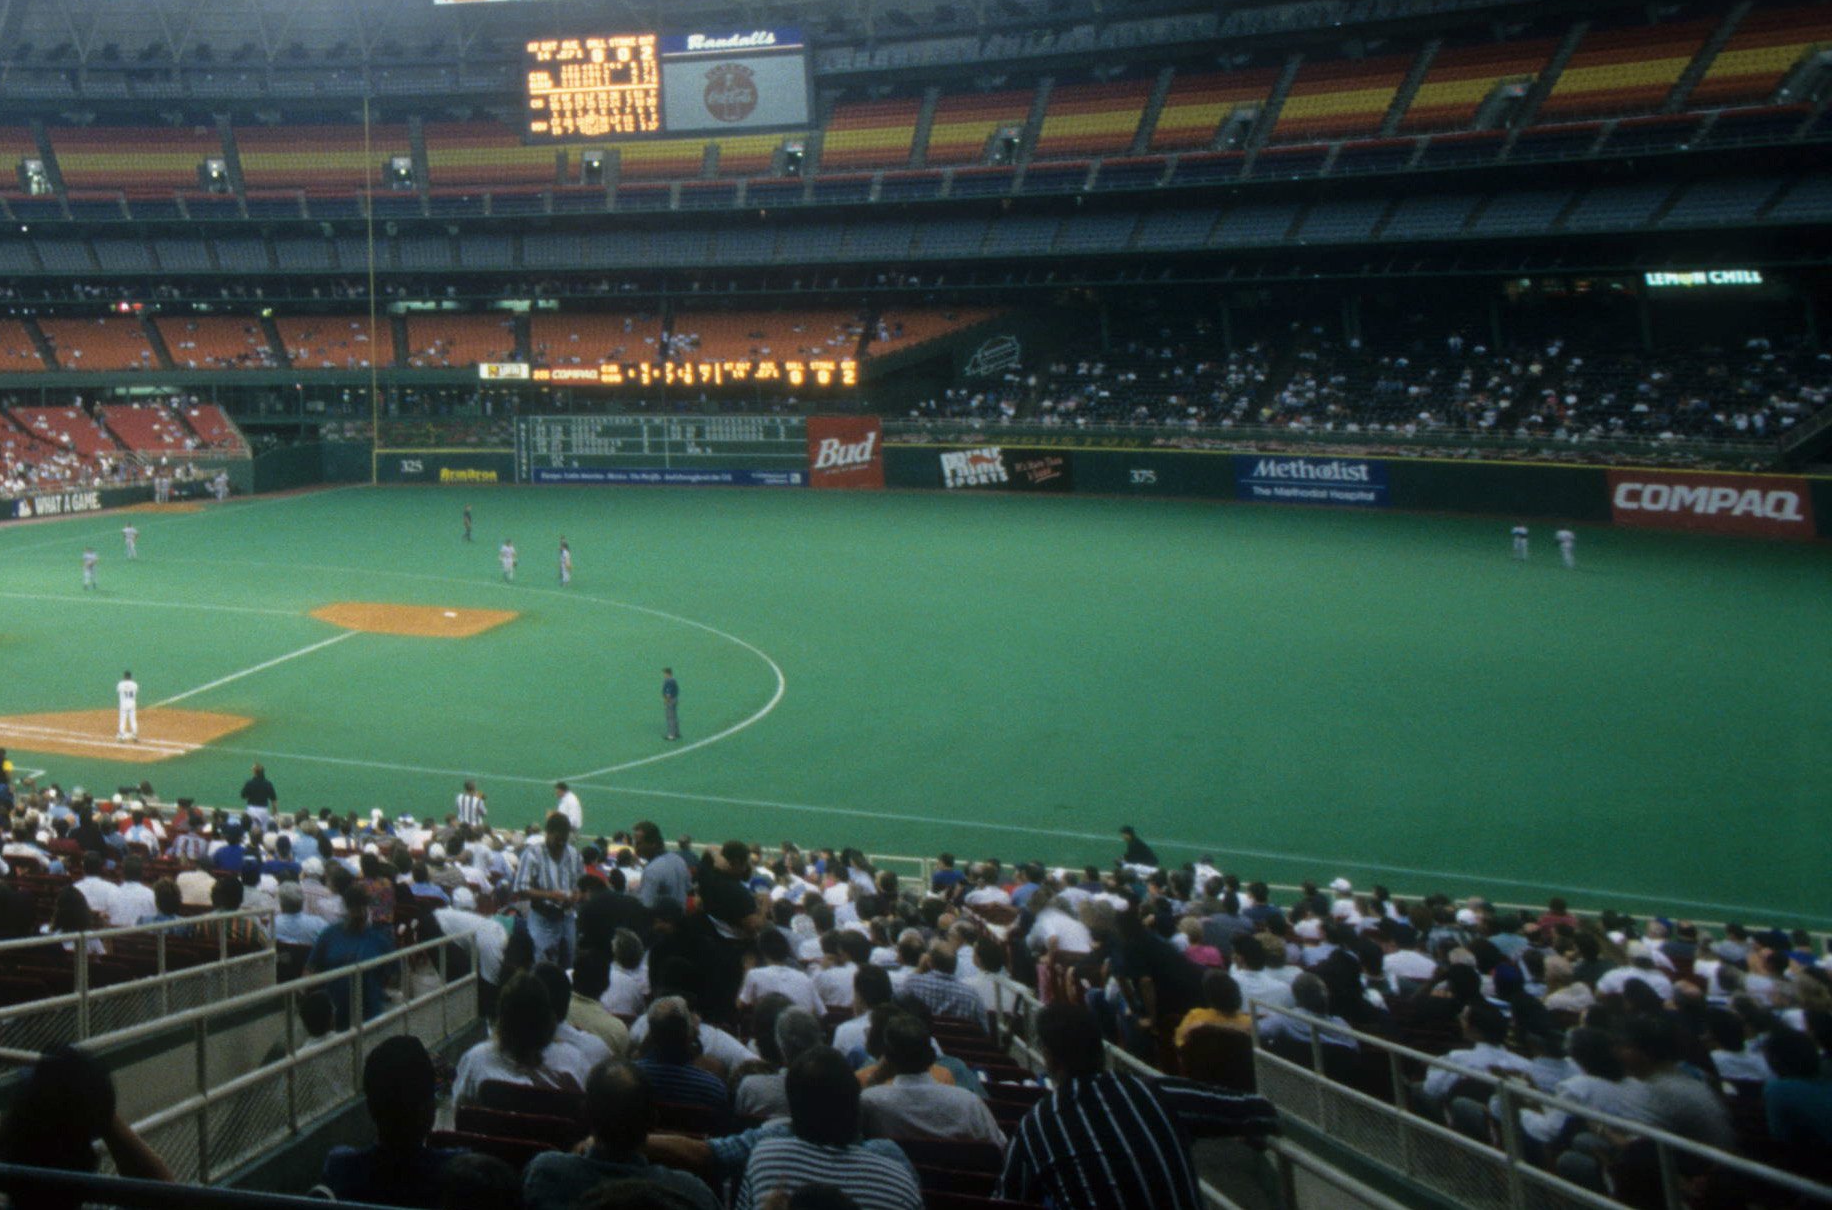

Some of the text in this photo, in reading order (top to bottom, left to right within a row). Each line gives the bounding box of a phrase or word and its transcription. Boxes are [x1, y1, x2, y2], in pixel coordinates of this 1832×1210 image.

[687, 30, 776, 50] Randalls
[1708, 270, 1763, 284] CHILL
[814, 431, 877, 469] Bud
[400, 459, 423, 473] 325
[1252, 459, 1369, 481] Methodist
[945, 471, 1009, 488] SPORTS
[1130, 469, 1157, 484] 375
[1252, 485, 1272, 496] The
[34, 491, 102, 516] WHAT A GAME.
[1613, 482, 1804, 521] COMPAQ
